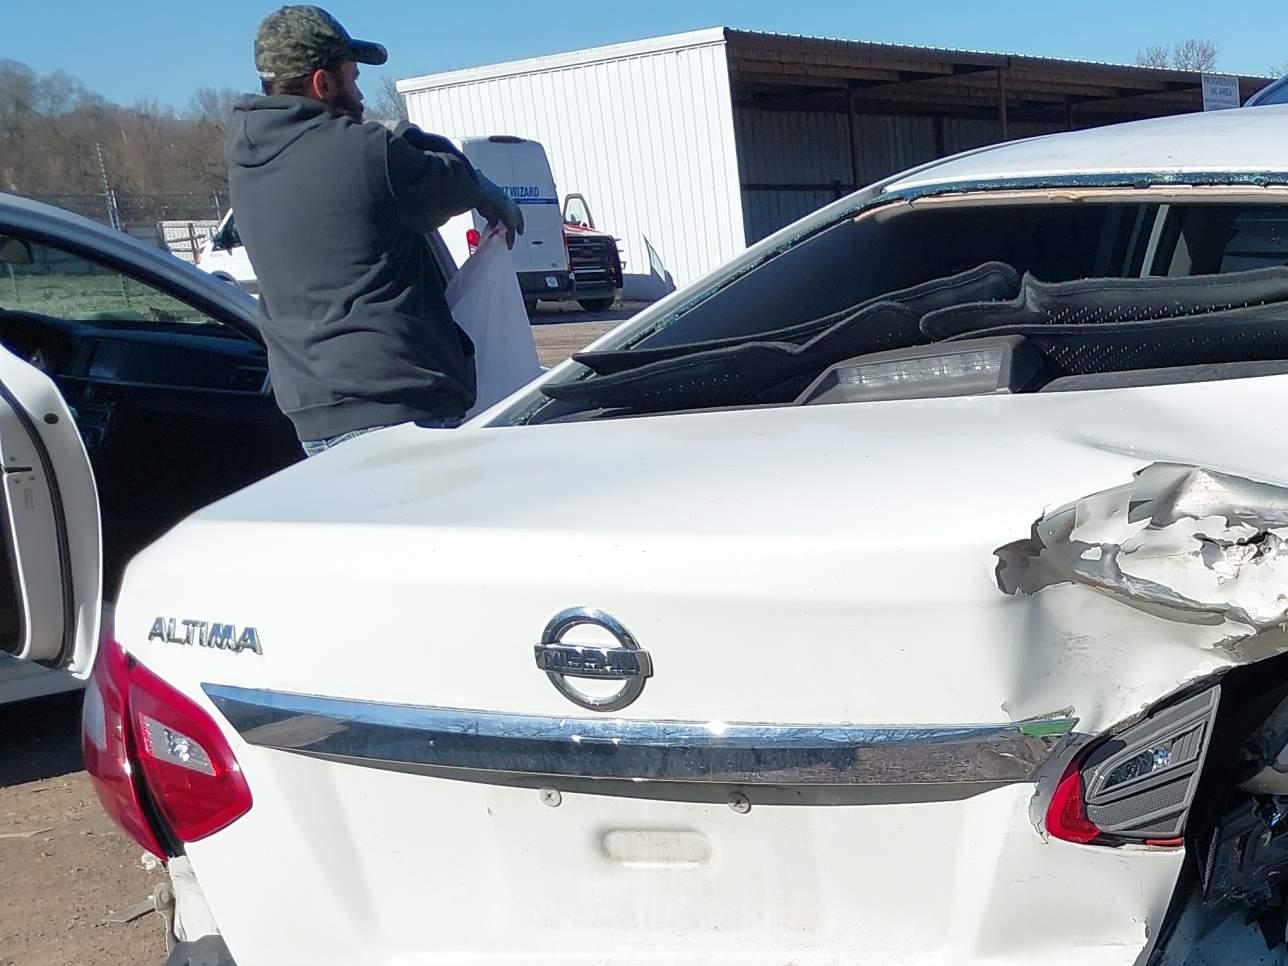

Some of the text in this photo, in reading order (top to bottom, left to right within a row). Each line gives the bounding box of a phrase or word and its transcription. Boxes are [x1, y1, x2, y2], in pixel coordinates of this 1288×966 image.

[1219, 87, 1232, 96] AREA
[510, 186, 540, 198] WIZARD
[147, 616, 263, 655] ALTIMA
